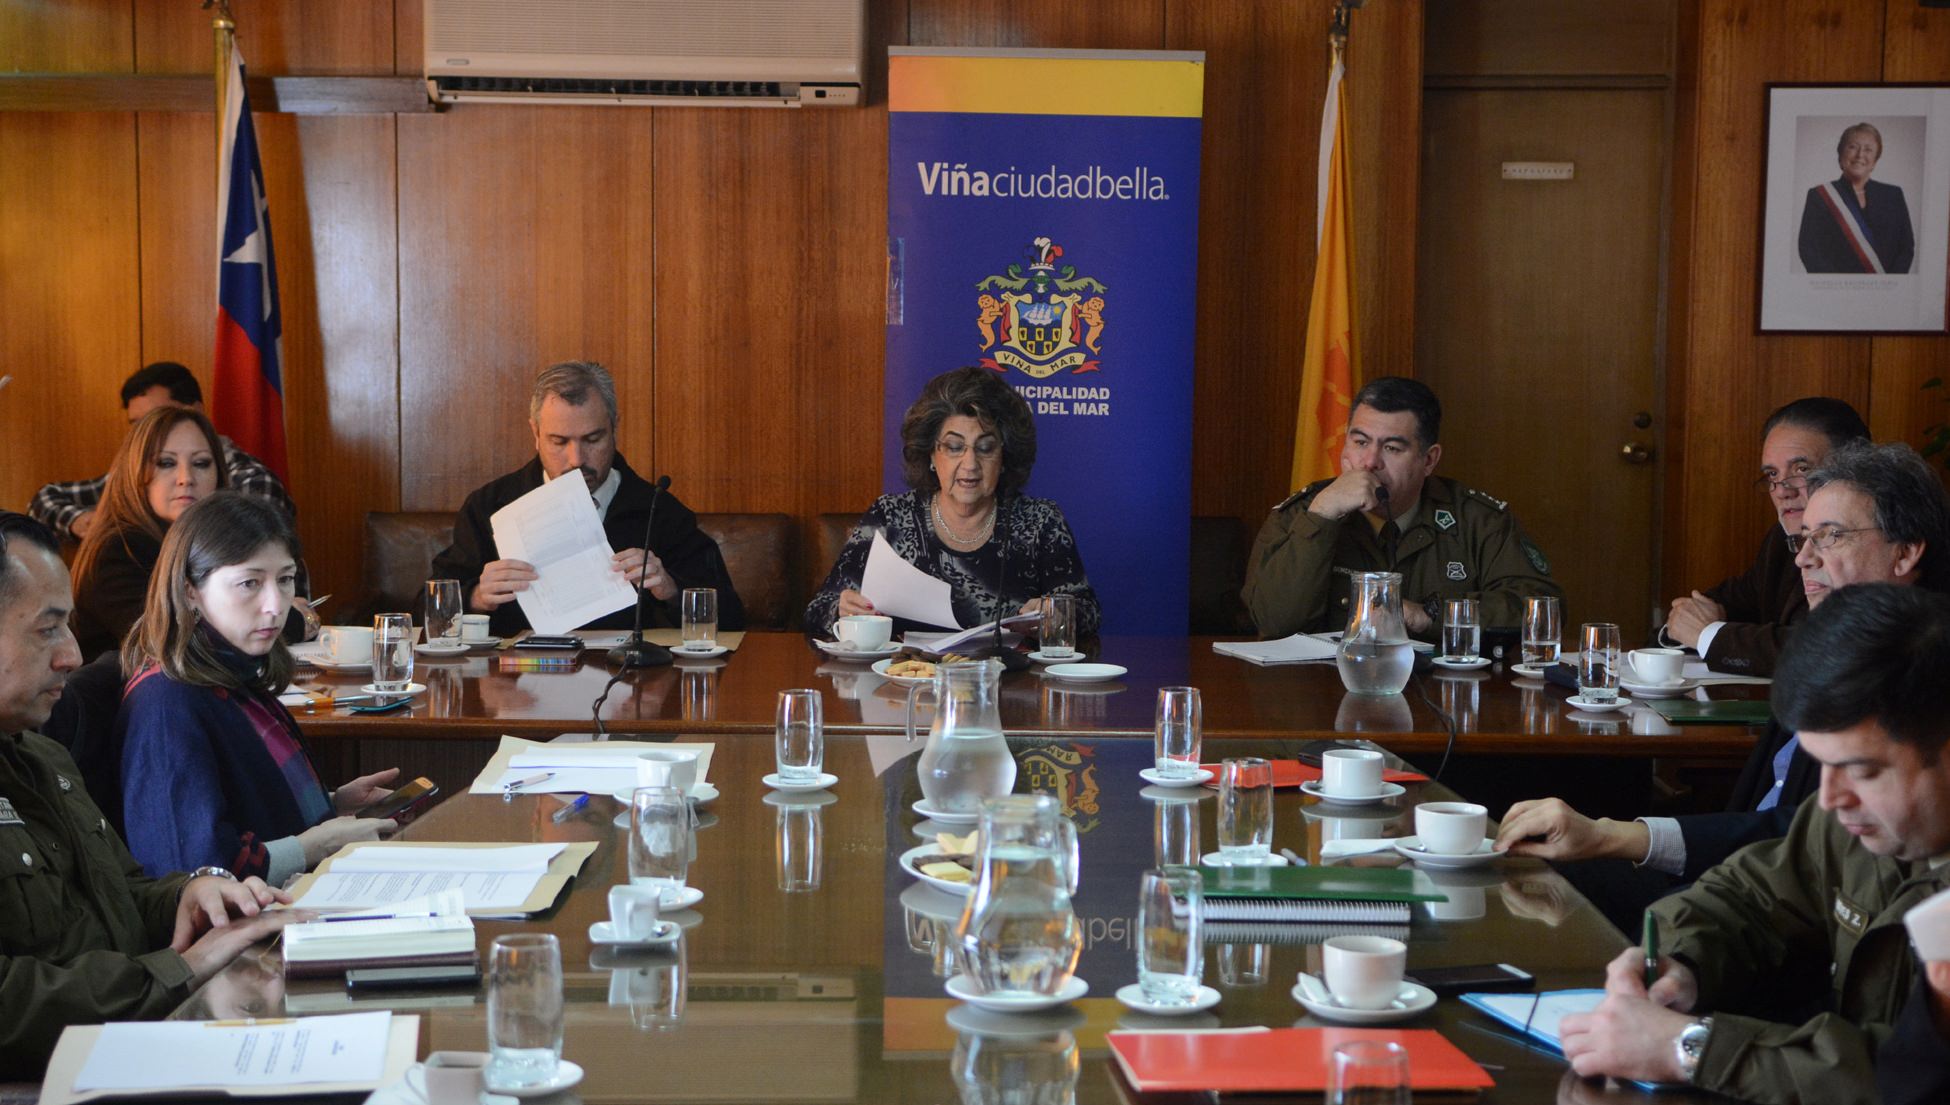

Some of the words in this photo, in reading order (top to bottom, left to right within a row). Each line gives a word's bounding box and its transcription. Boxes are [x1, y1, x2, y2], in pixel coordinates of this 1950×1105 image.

[1050, 356, 1076, 371] MAR
[1015, 385, 1110, 400] ICIPALIDAD
[1037, 401, 1069, 415] DEL
[1073, 402, 1110, 416] MAR
